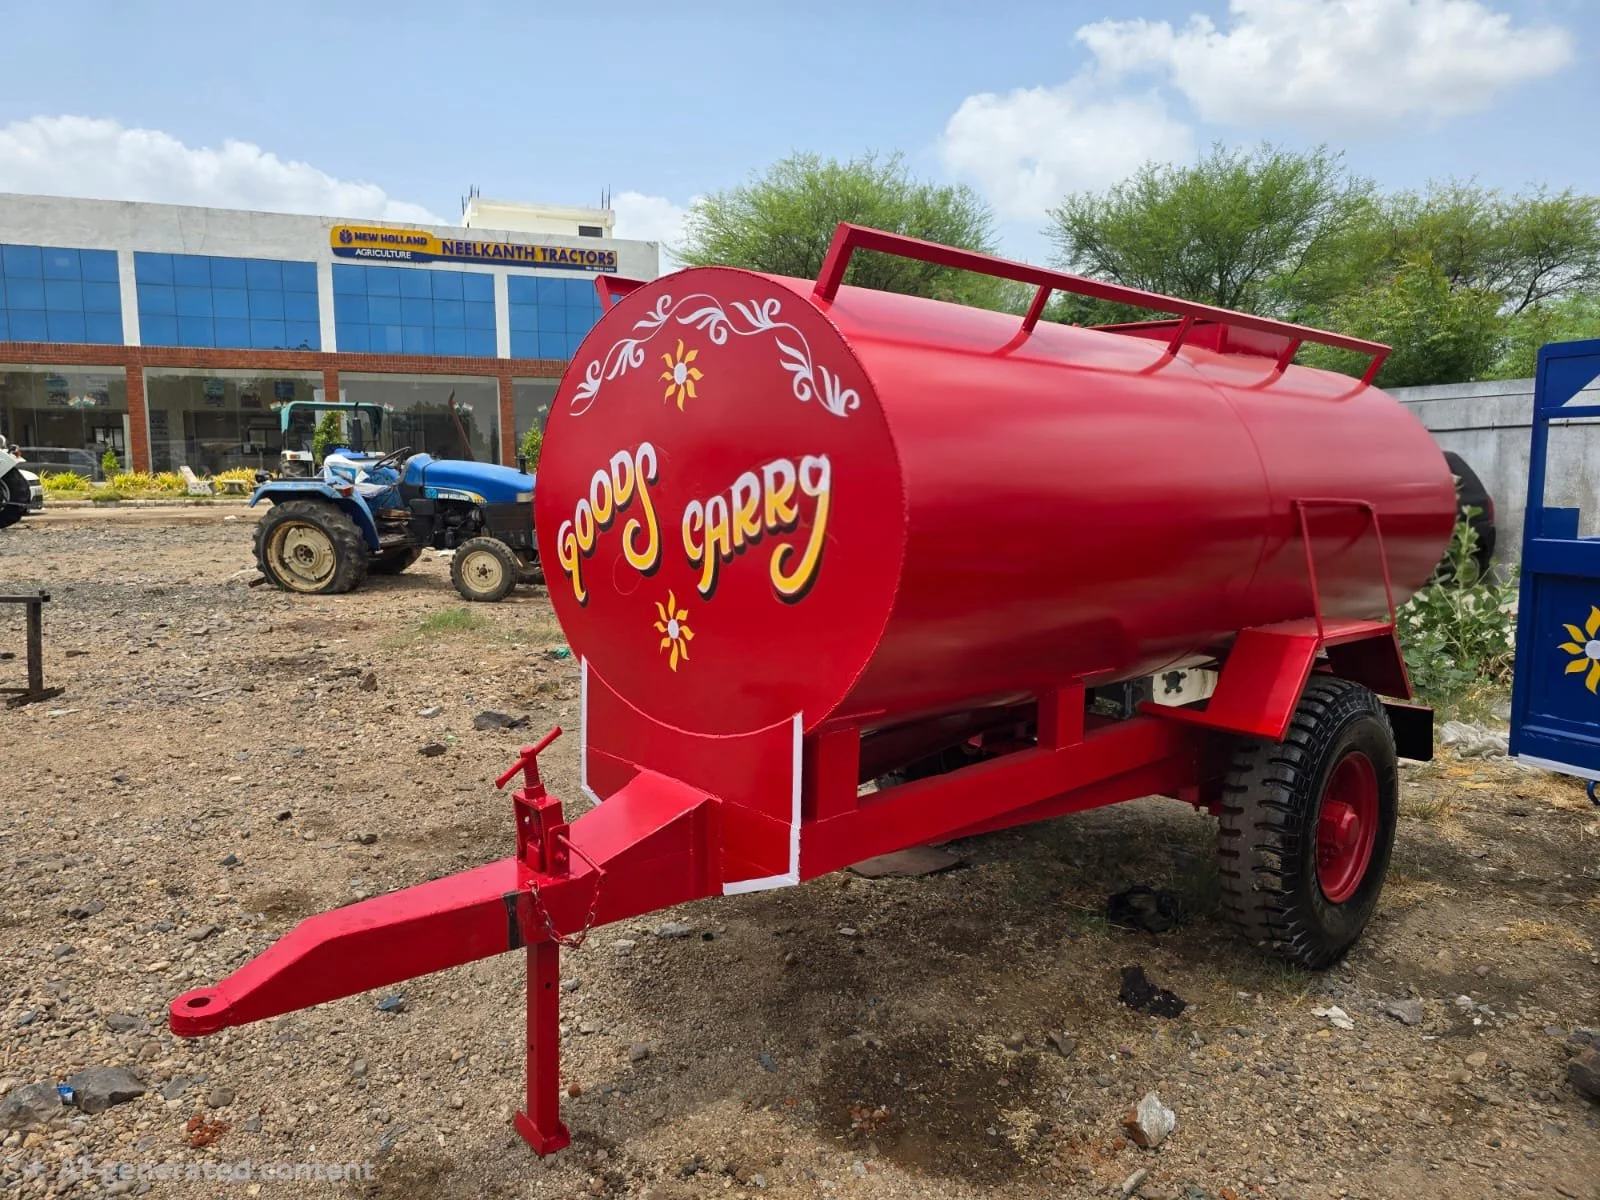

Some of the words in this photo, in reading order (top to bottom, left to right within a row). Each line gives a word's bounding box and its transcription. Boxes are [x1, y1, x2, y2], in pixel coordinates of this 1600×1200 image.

[354, 231, 378, 241] NEW
[380, 234, 427, 246] HOLLAND
[355, 248, 412, 259] AGRICULTURE
[441, 240, 535, 261] NEELKANTH
[540, 247, 615, 266] TRACTORS
[557, 442, 660, 607] GOODS
